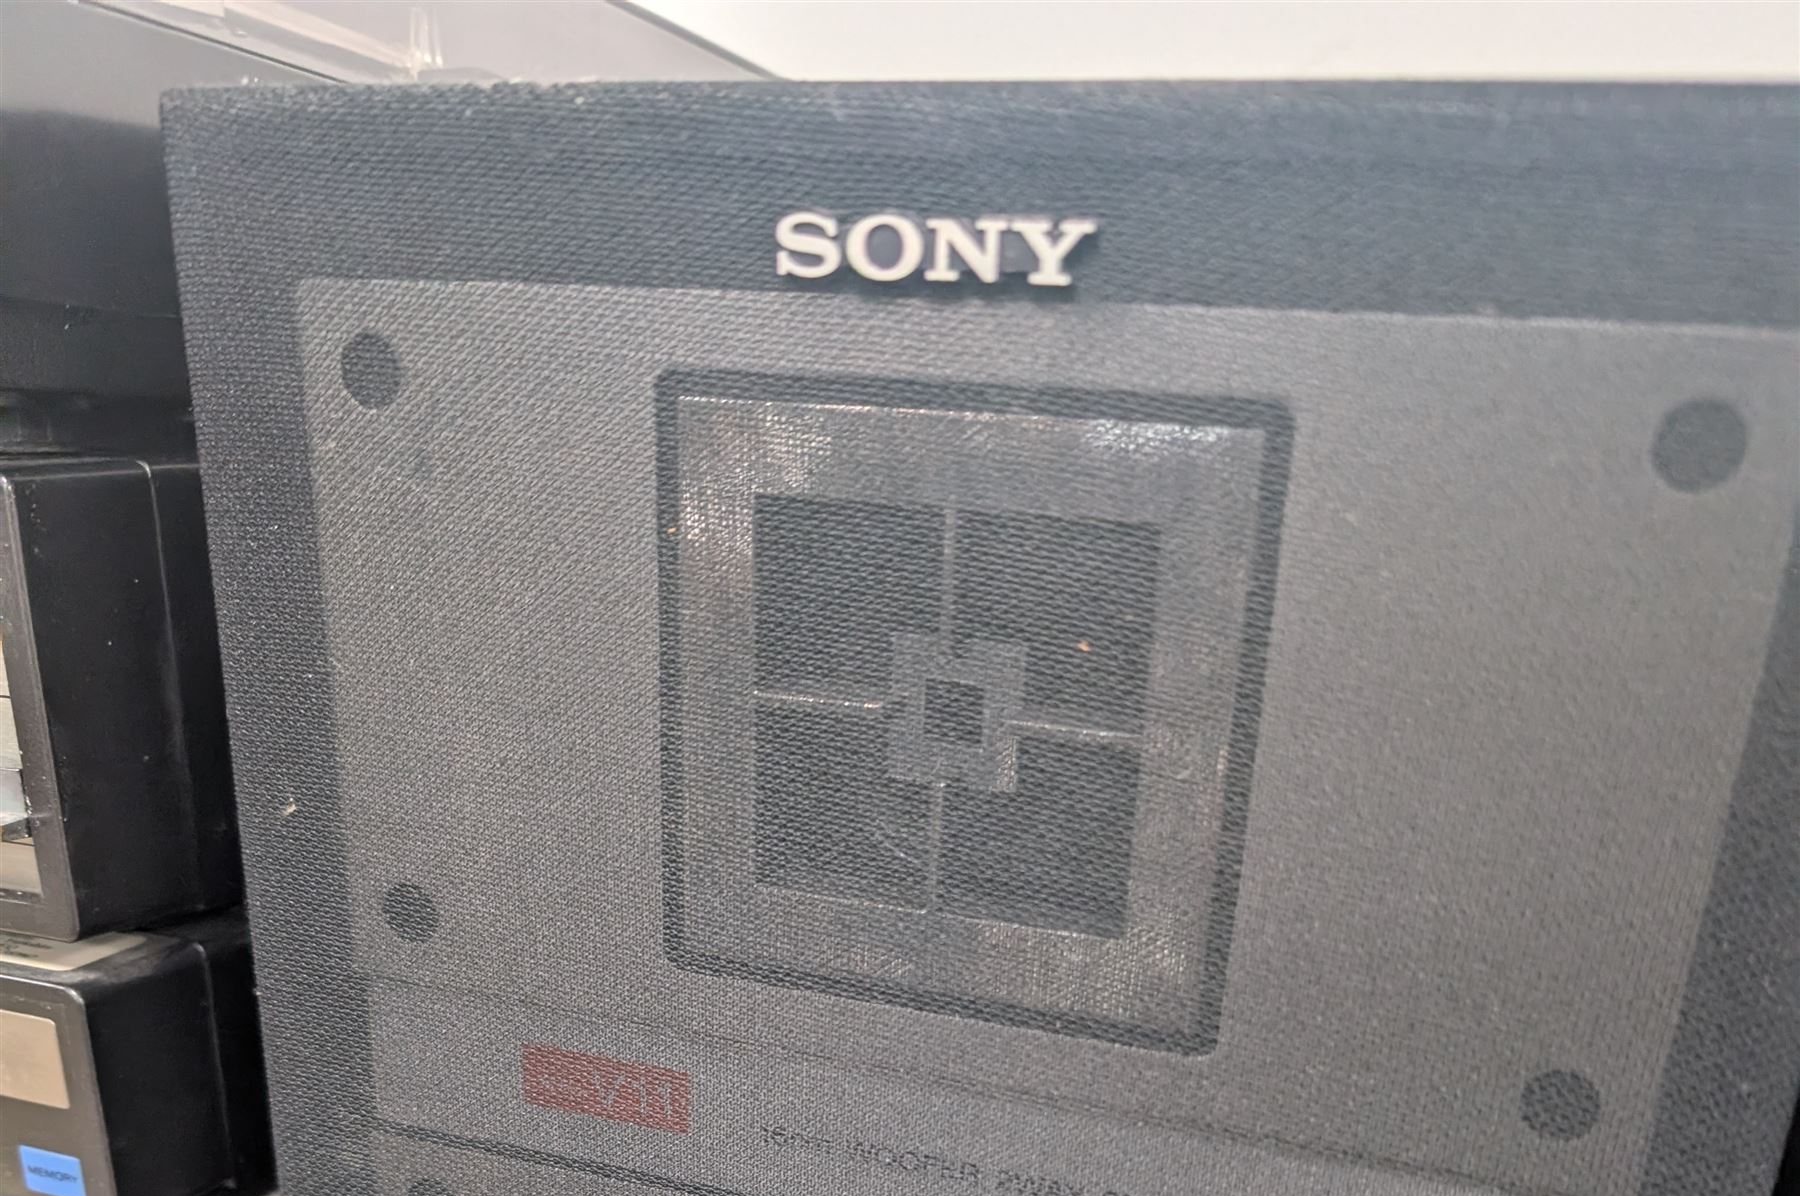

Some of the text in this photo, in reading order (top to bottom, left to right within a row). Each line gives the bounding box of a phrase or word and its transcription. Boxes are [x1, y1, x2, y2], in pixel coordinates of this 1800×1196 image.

[775, 212, 1097, 286] SONY
[27, 1165, 78, 1183] MEMORY
[846, 1138, 980, 1186] WOOFER
